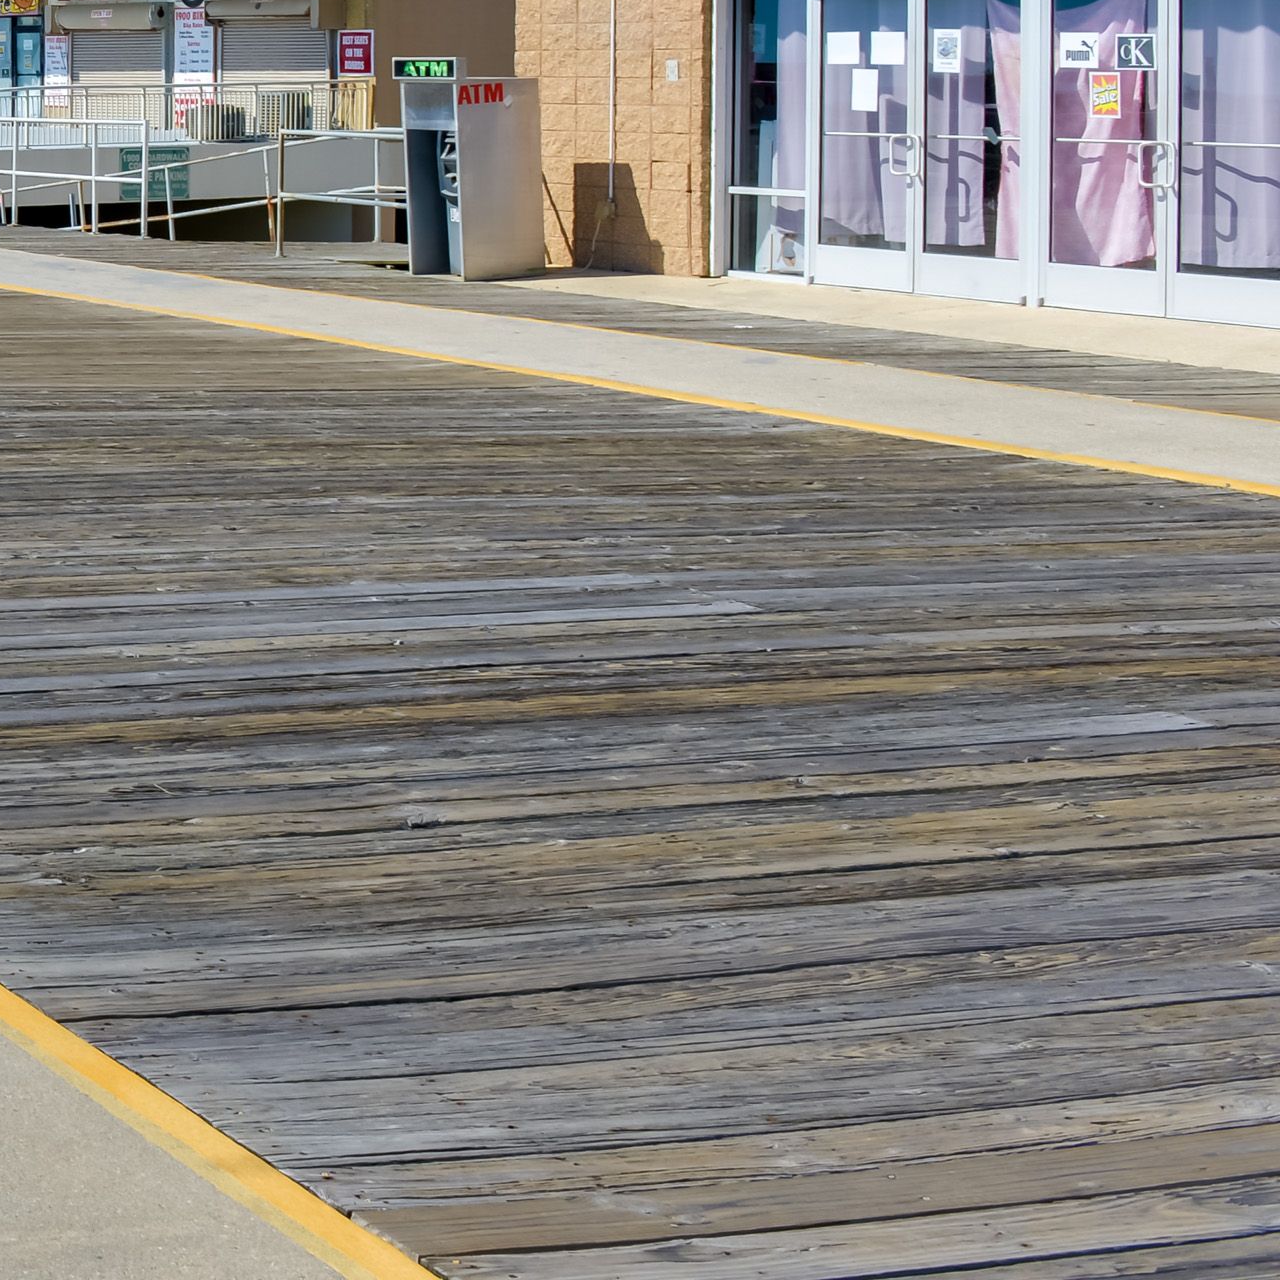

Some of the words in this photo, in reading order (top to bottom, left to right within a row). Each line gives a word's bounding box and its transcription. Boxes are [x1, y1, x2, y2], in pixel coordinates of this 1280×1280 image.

[192, 11, 204, 20] BIK
[1065, 50, 1090, 62] PUMA
[403, 61, 448, 77] ATM
[458, 82, 504, 105] ATM
[1093, 92, 1118, 106] Sale
[148, 153, 188, 161] OARDWALK
[154, 171, 188, 181] PAKING
